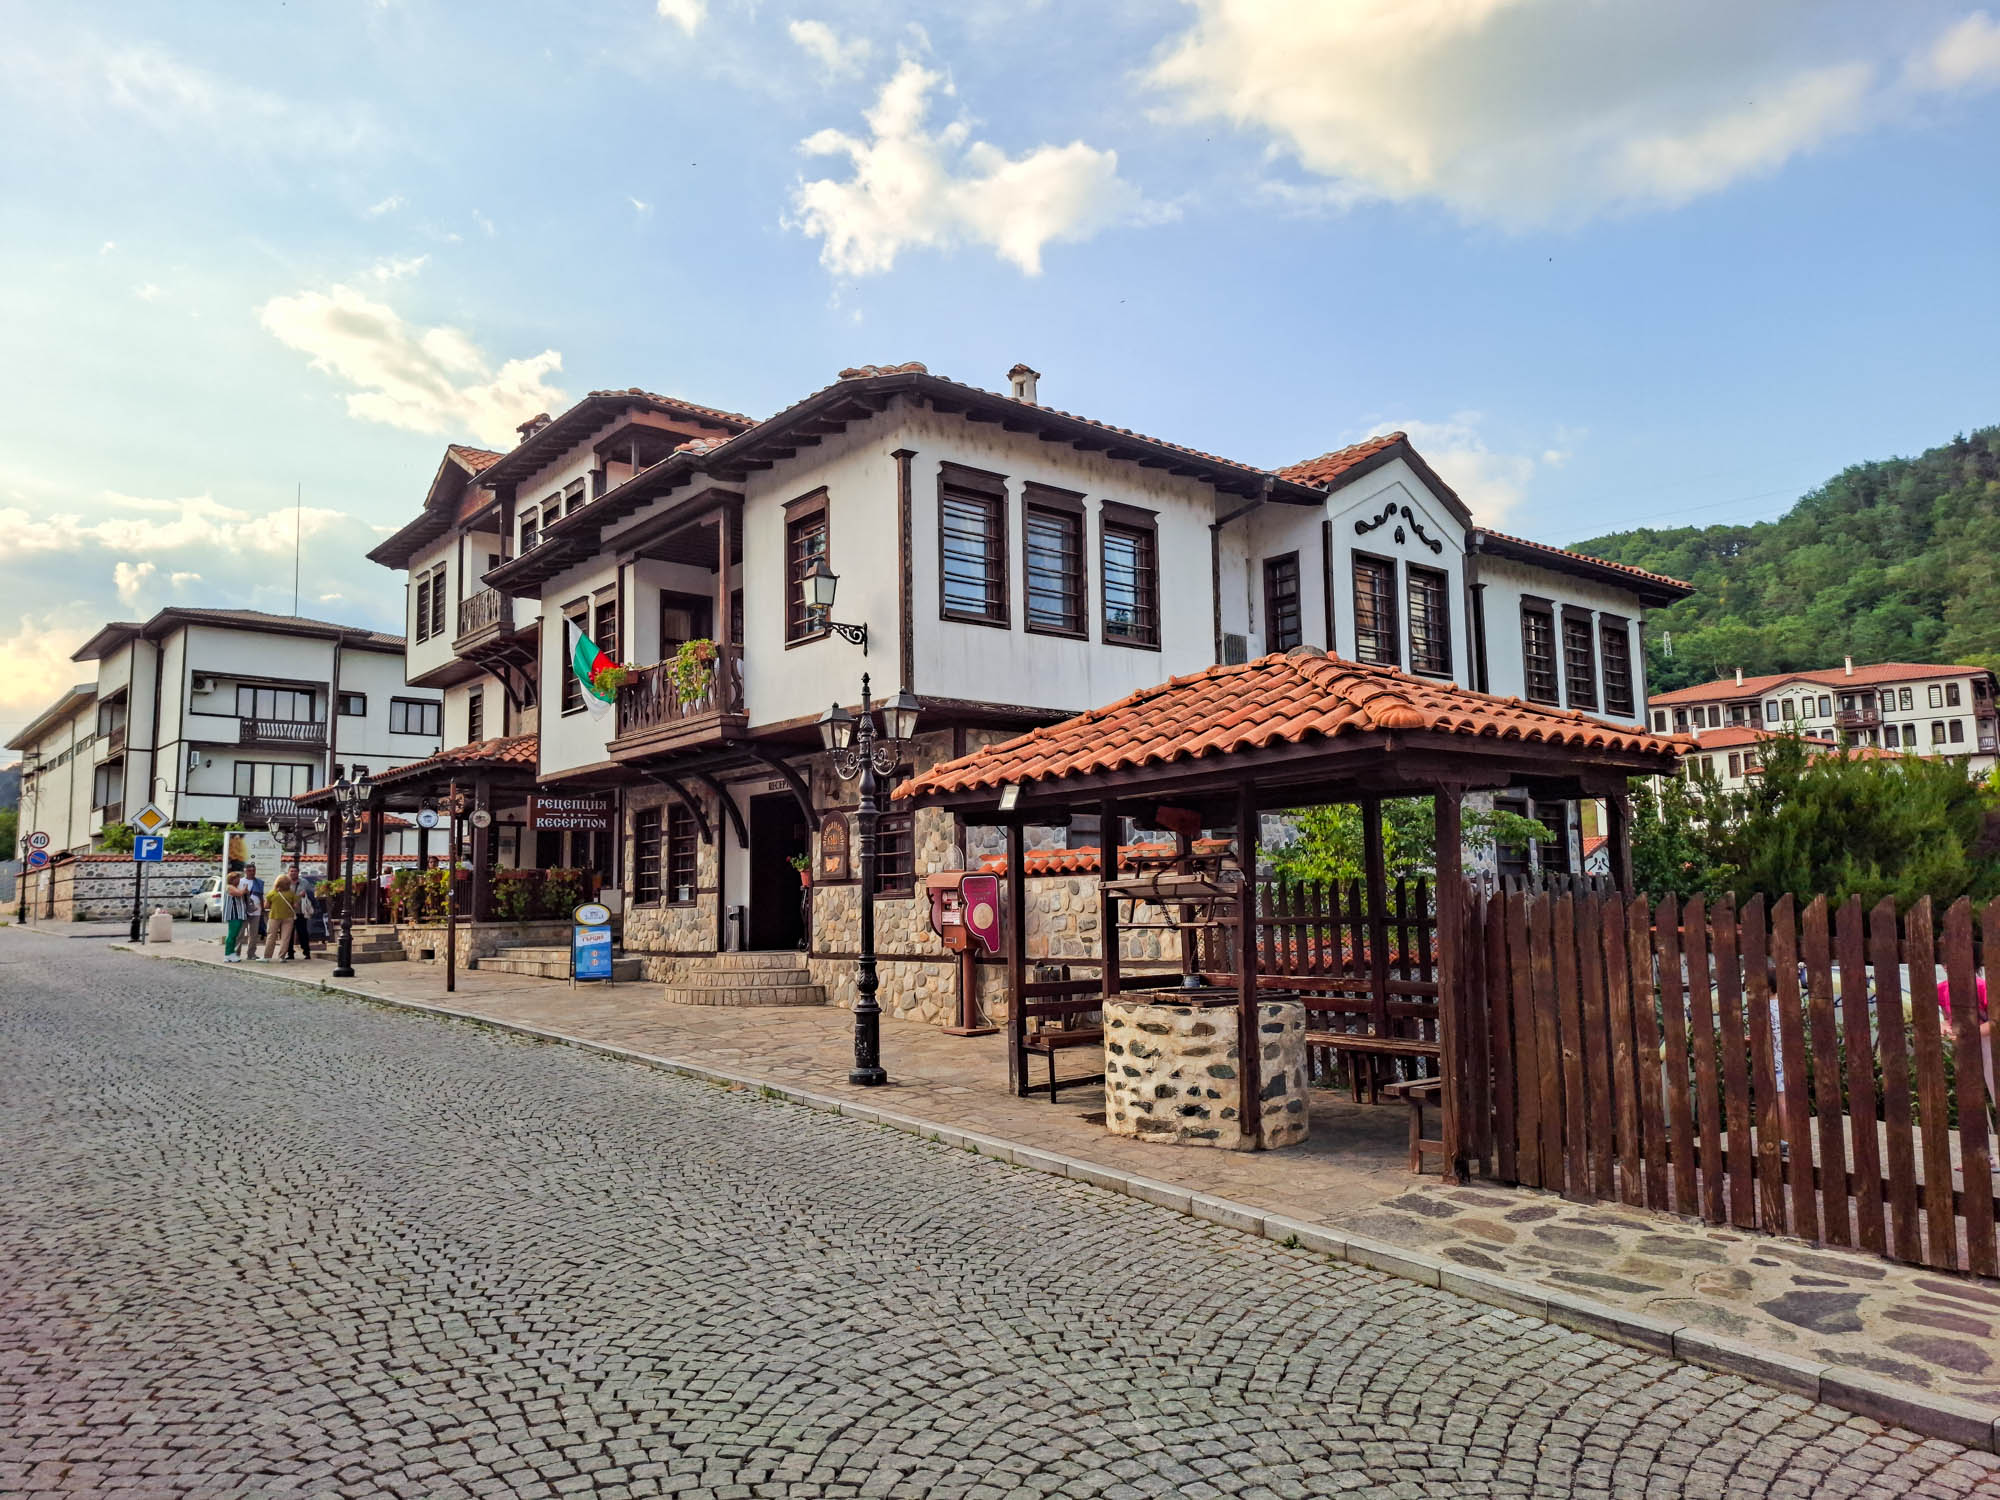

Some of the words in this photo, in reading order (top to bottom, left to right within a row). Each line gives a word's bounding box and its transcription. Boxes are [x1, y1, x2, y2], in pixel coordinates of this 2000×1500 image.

[537, 799, 607, 811] РЕЦЕПЦИЯ
[536, 817, 607, 828] RECEPTION
[33, 836, 46, 845] 40
[141, 839, 158, 858] P
